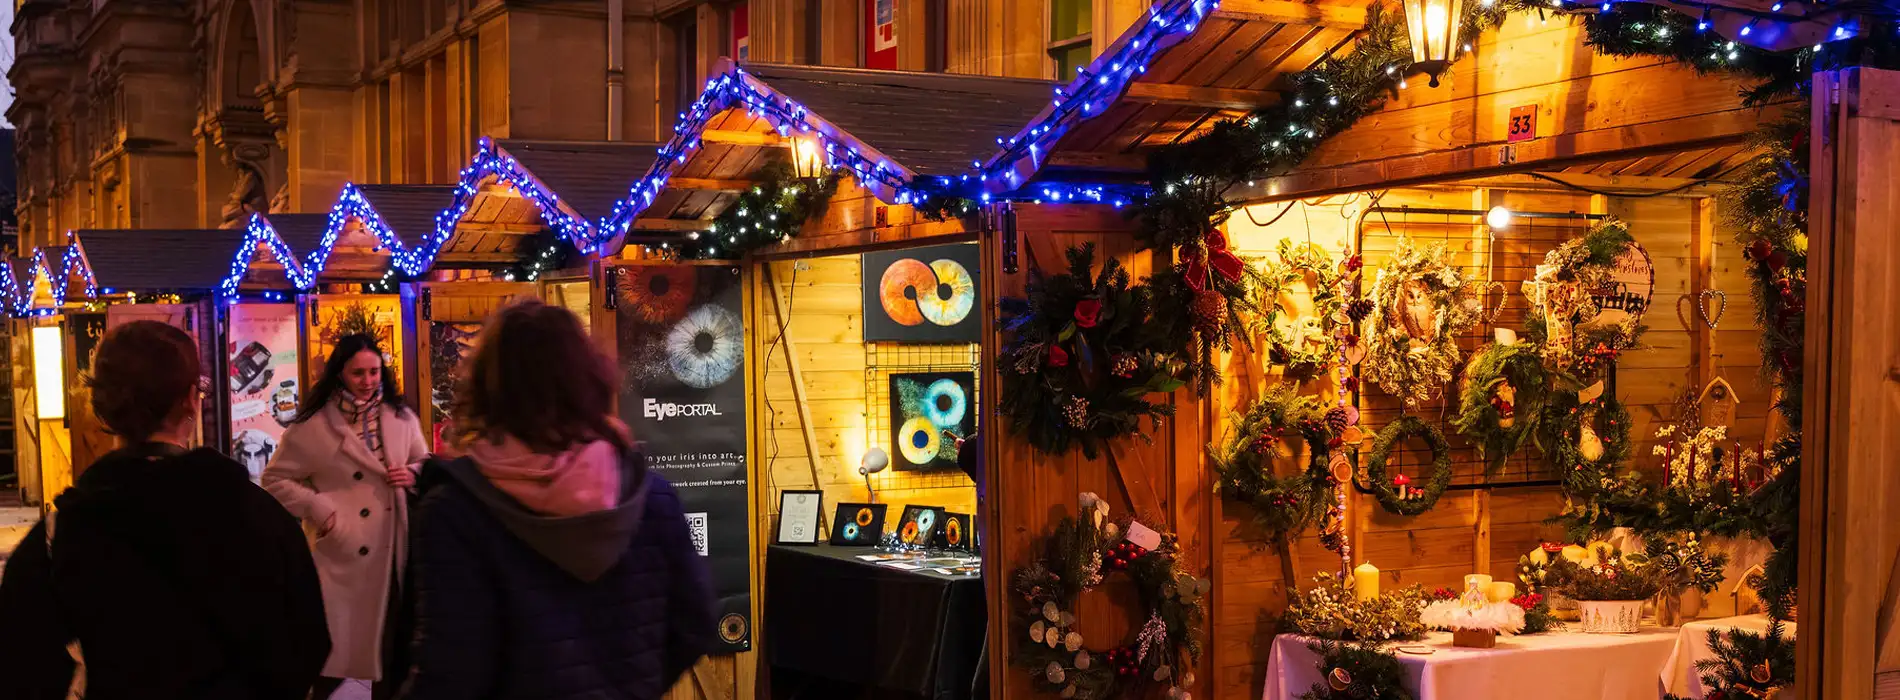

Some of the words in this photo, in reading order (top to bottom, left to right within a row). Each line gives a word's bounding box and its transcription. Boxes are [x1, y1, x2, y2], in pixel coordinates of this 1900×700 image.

[1511, 115, 1531, 135] 33
[656, 455, 677, 464] your
[680, 453, 695, 461] iris
[698, 452, 717, 460] into
